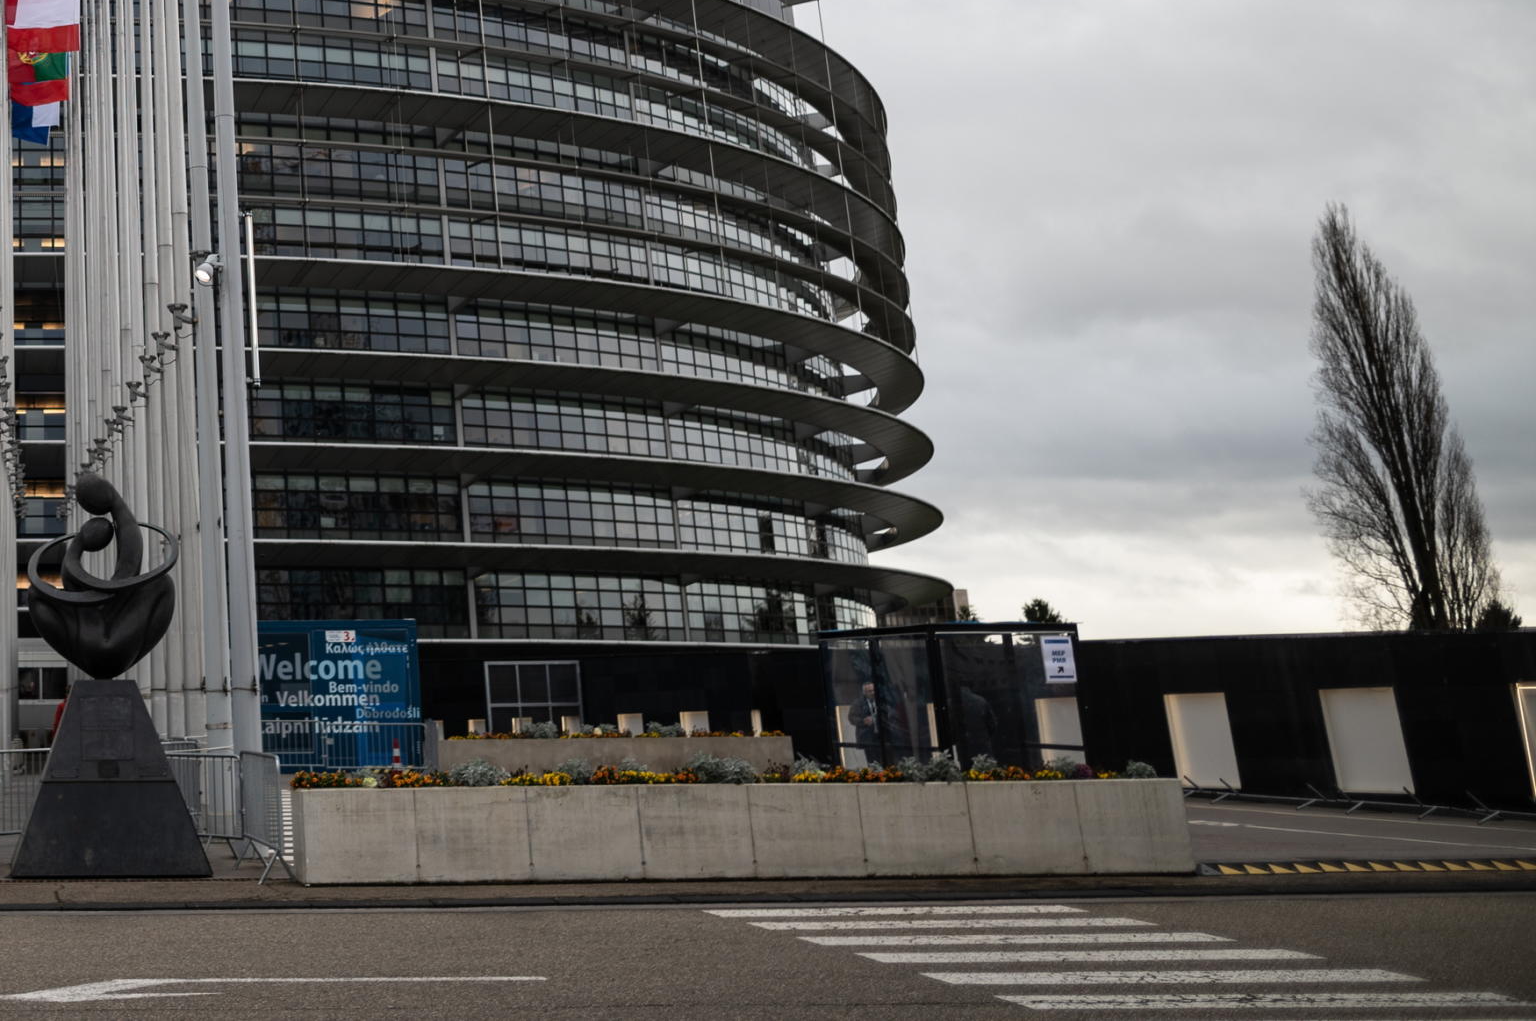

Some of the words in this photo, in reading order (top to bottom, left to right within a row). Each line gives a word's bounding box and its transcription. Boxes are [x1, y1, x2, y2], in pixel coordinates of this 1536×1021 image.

[325, 642, 364, 655] Καλώς
[258, 653, 382, 680] Welcome
[329, 681, 399, 694] Bem-vindo
[276, 690, 380, 707] Velkommen
